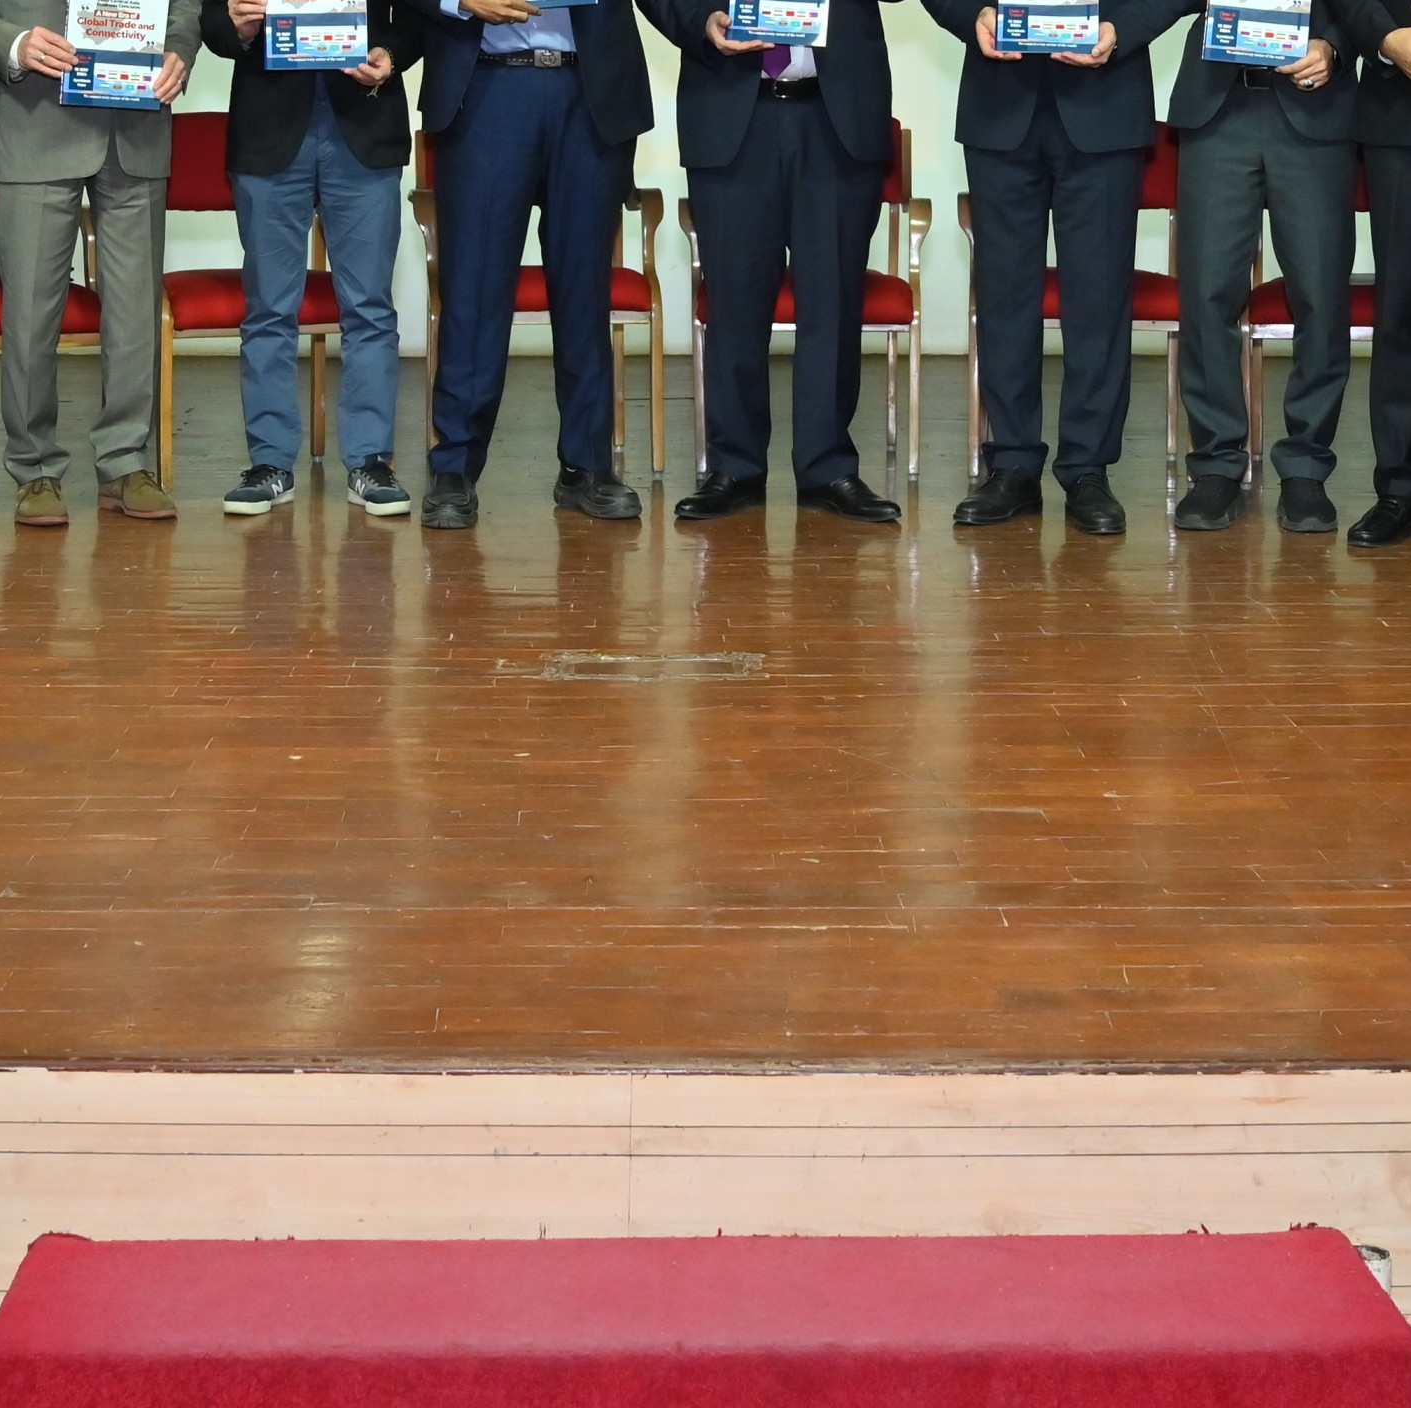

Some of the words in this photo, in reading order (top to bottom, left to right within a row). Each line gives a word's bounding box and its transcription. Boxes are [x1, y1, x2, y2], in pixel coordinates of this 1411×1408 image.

[77, 17, 108, 27] Global
[109, 20, 136, 29] Trade
[86, 29, 145, 41] Connectivity
